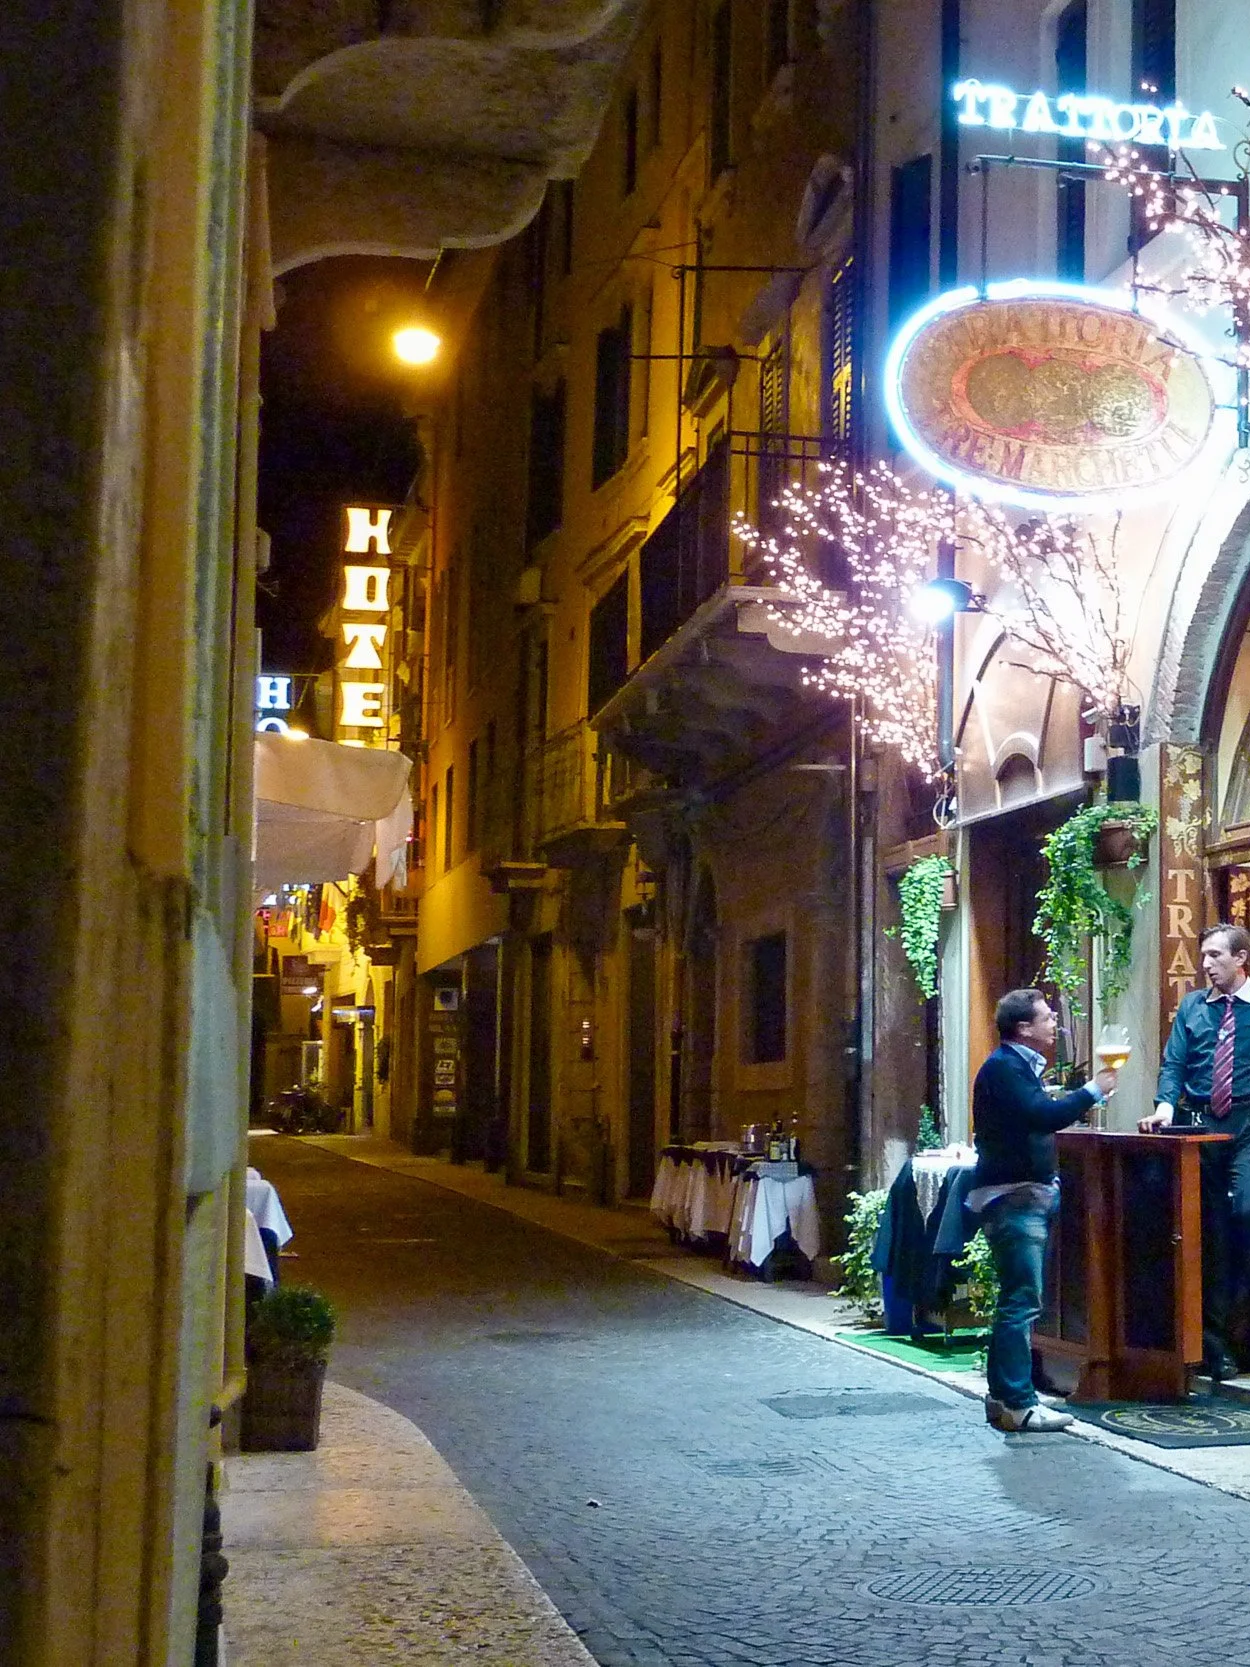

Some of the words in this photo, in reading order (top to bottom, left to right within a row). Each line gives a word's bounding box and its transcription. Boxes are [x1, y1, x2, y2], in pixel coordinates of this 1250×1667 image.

[954, 79, 1226, 150] TRATTORIA
[339, 507, 393, 748] HOTE
[1166, 868, 1198, 1023] TRAT
